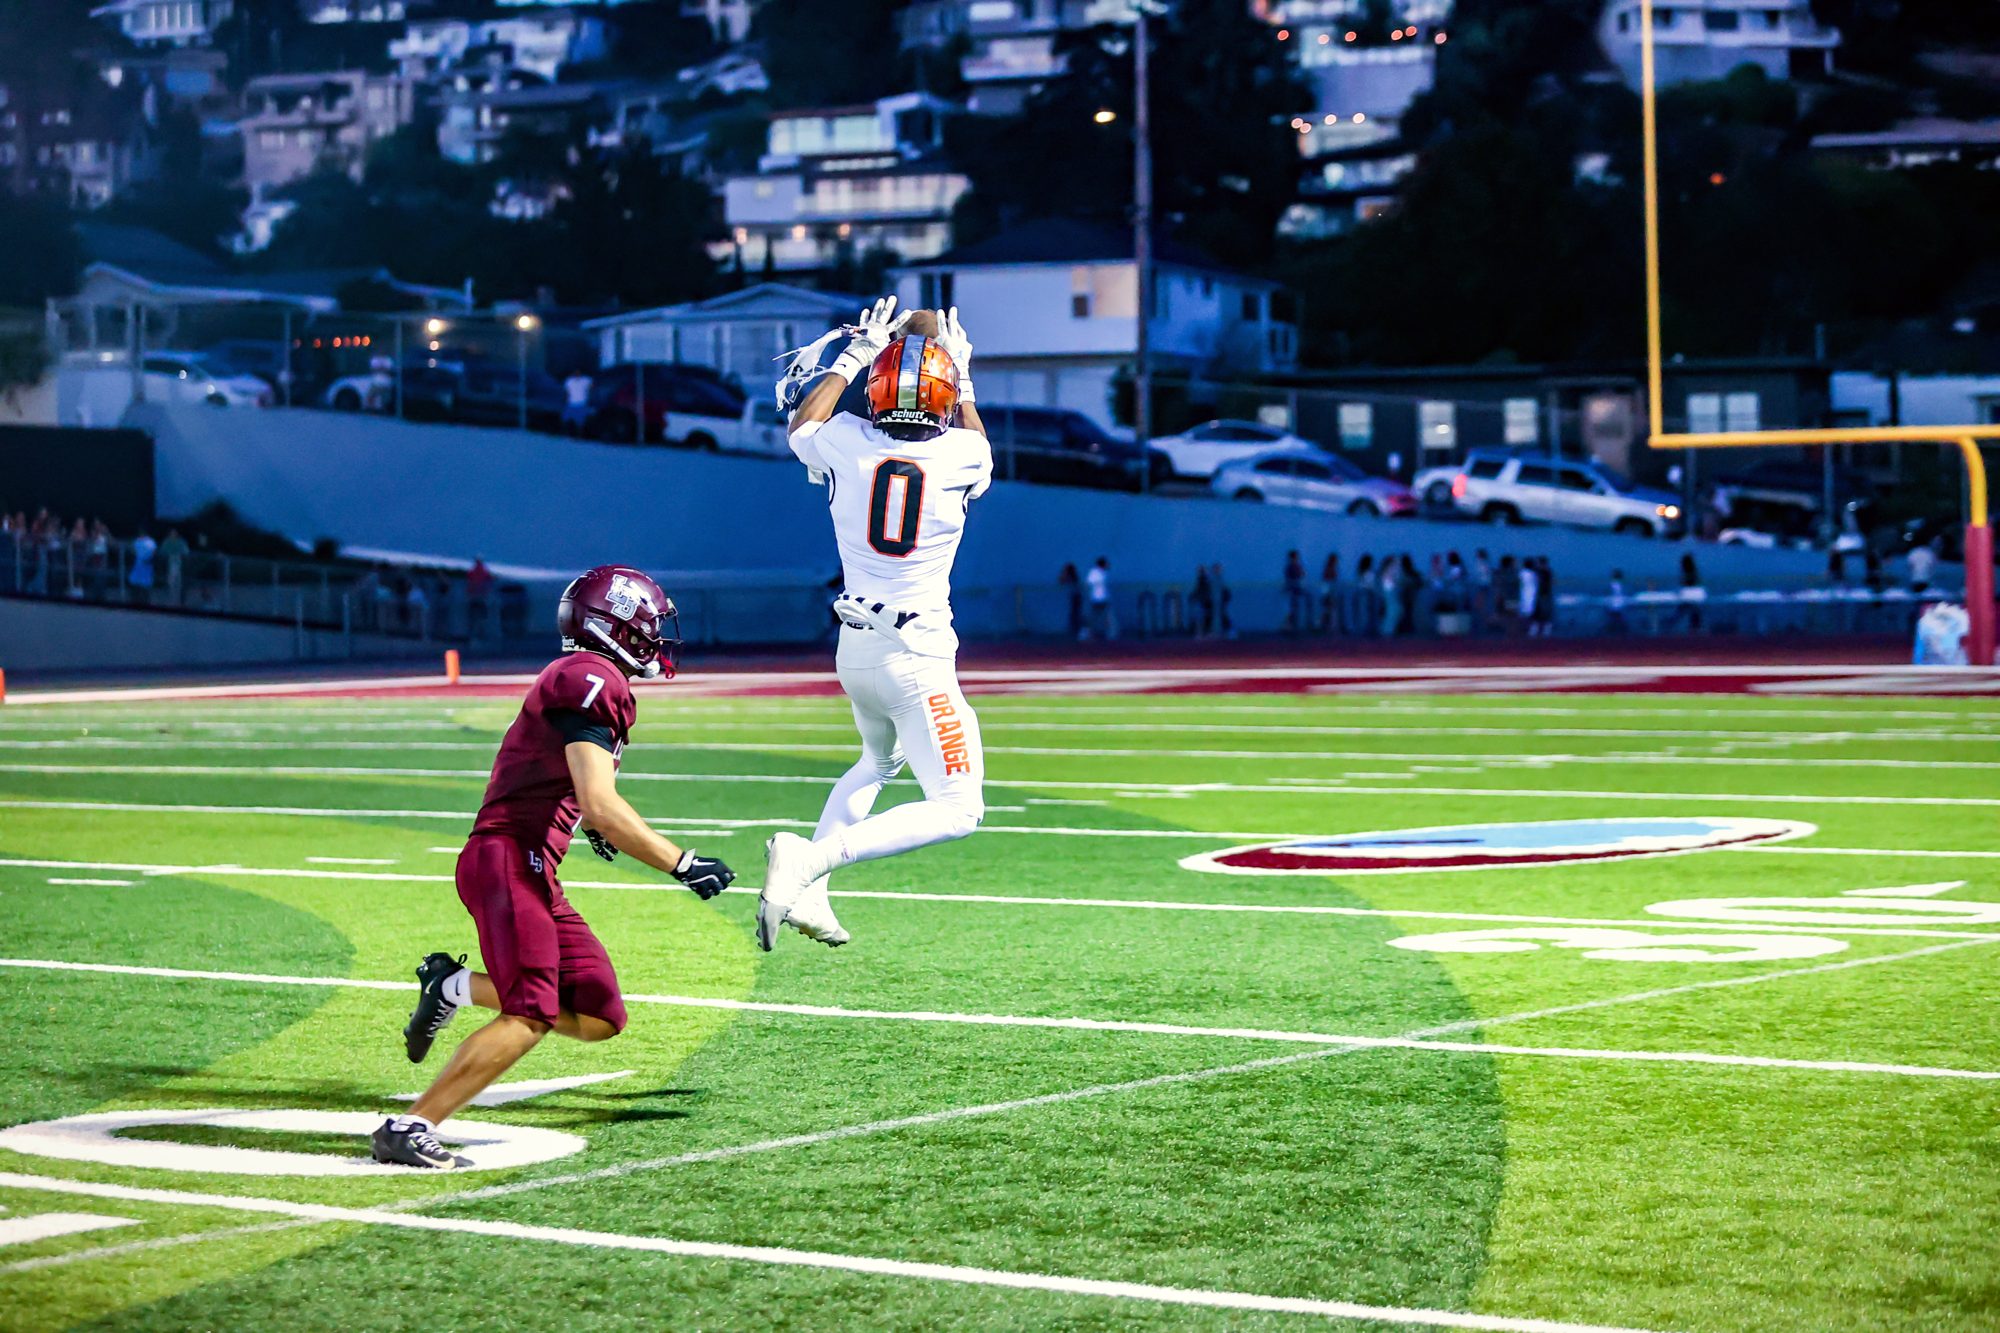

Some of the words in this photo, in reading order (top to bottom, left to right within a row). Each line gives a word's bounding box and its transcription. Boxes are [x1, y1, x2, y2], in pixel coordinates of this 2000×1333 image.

[891, 408, 925, 419] schutt
[867, 456, 926, 558] 0
[581, 672, 606, 709] 7
[928, 693, 970, 776] ORANGE
